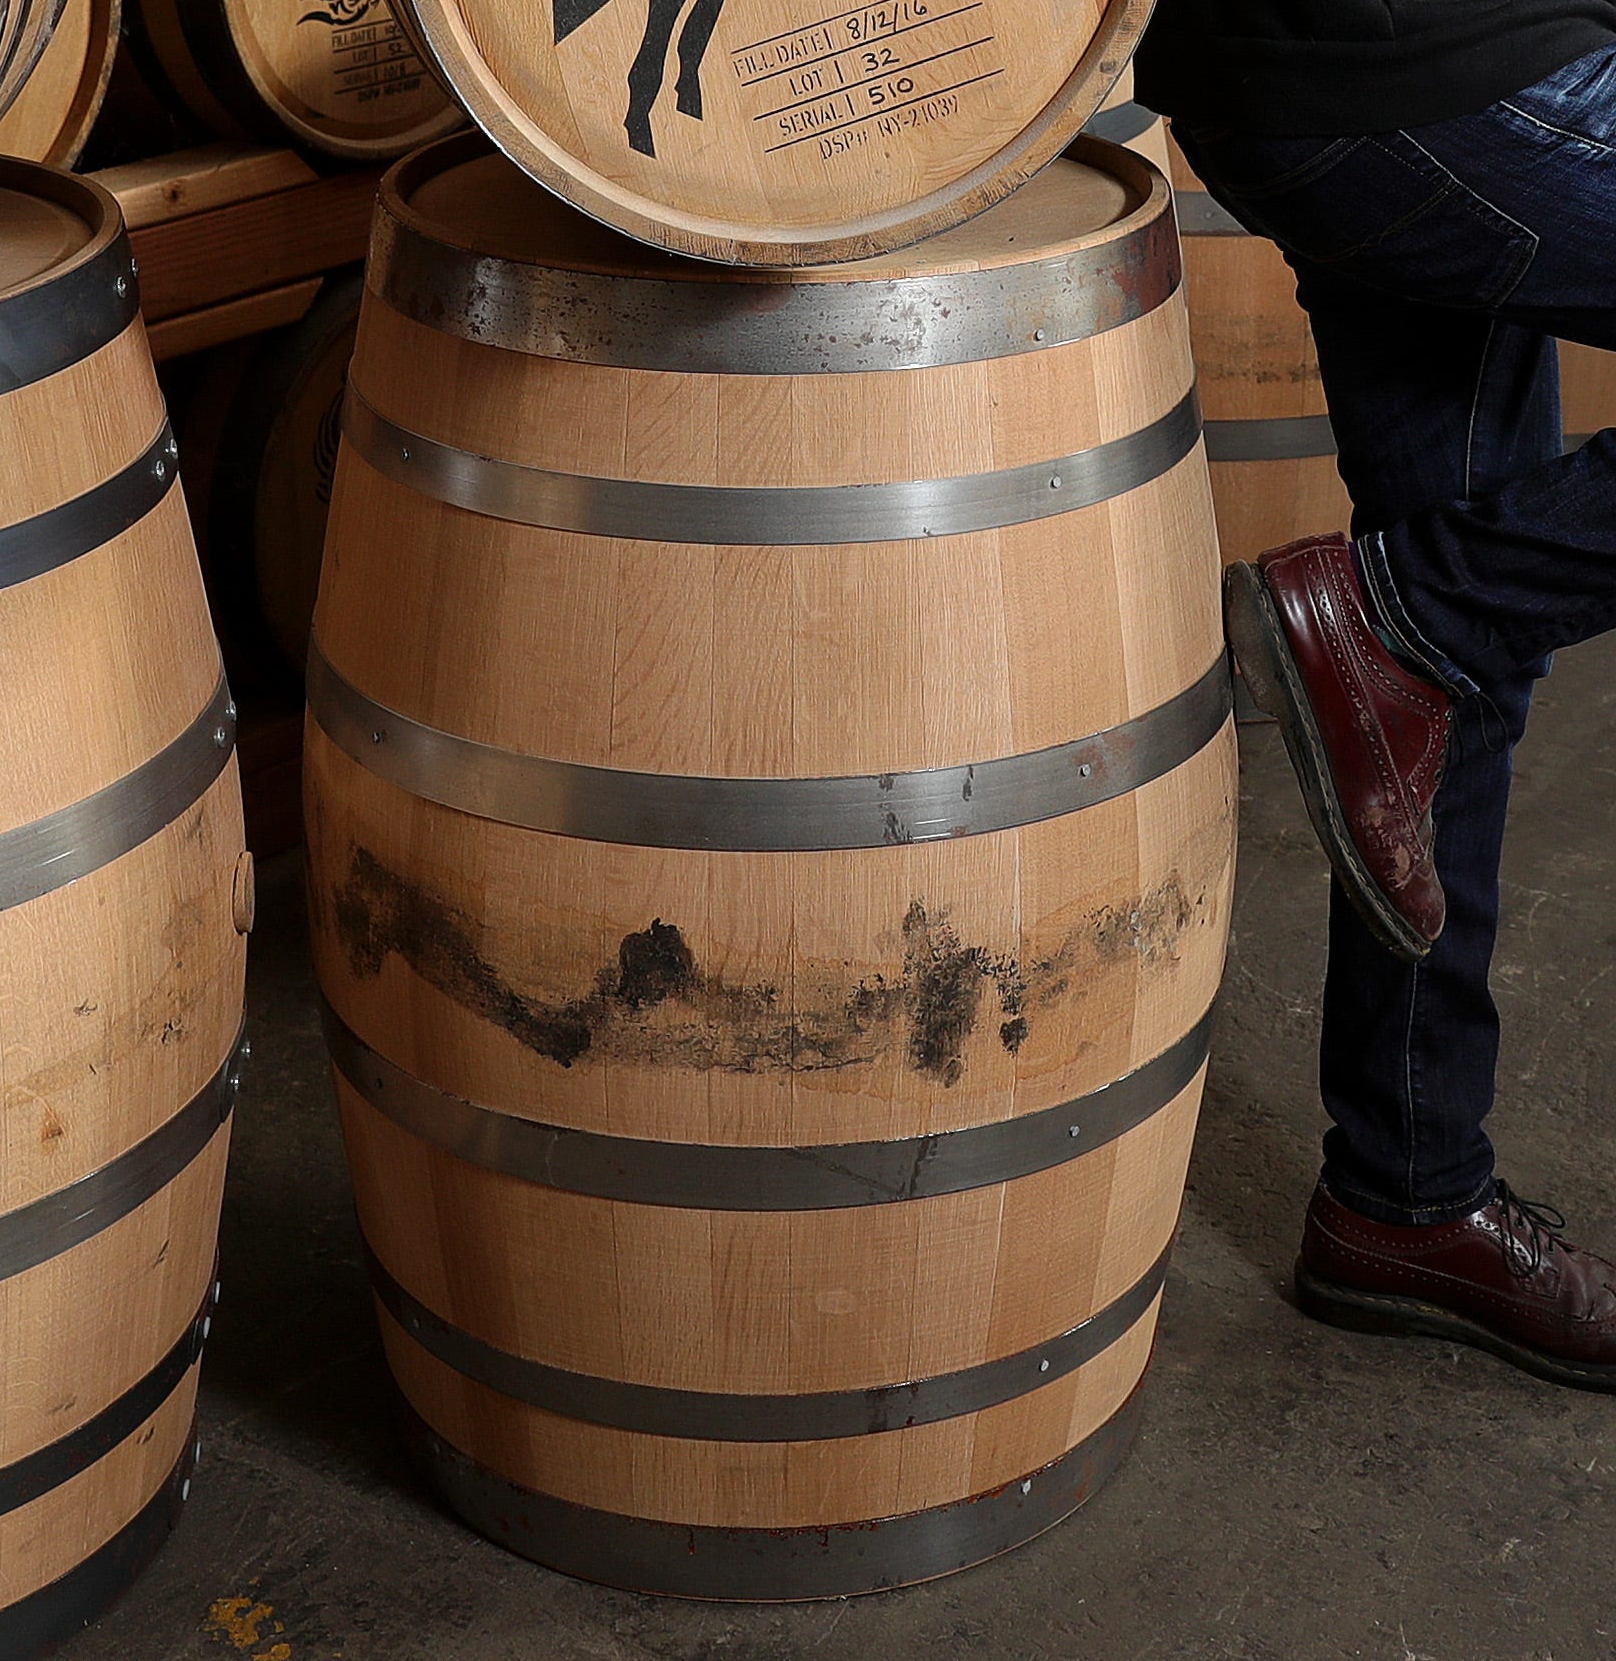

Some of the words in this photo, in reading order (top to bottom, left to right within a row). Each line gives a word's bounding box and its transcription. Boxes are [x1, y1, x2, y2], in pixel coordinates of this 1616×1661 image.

[733, 54, 774, 78] FILL
[777, 32, 825, 62] DATE
[846, 0, 928, 40] 8/12/16
[789, 67, 824, 96] LOT
[861, 48, 900, 73] 32
[779, 103, 844, 137] SERIAL
[868, 77, 914, 106] 510
[877, 95, 959, 138] NY-21039
